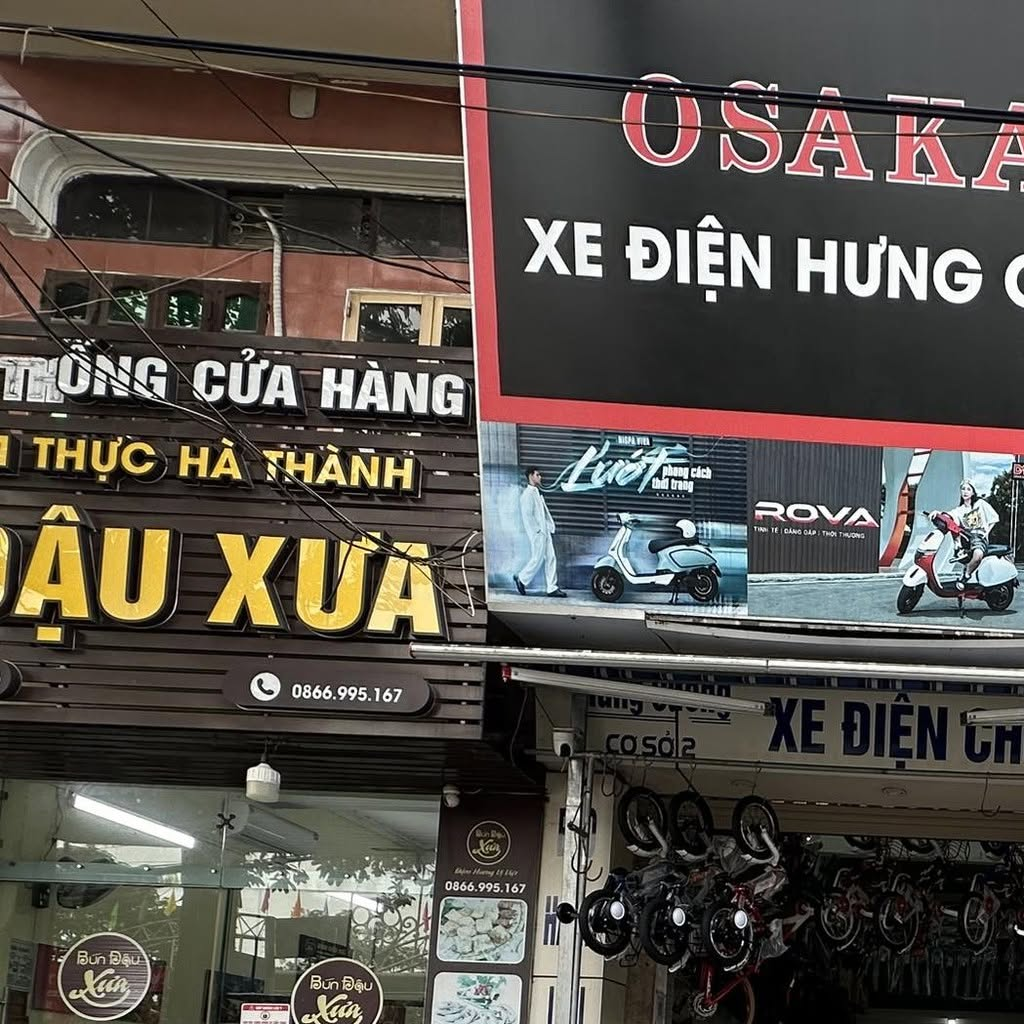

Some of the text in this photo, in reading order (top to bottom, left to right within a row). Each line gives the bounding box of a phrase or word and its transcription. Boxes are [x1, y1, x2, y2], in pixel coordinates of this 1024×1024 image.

[523, 217, 603, 278] XE
[625, 213, 772, 303] ĐIỆN
[797, 234, 983, 305] HƯNG
[192, 348, 299, 407] CỬA
[320, 360, 465, 416] HÀNG
[32, 436, 157, 482] THỰC
[178, 437, 243, 480] HÀ
[262, 443, 414, 490] THÀNH
[662, 464, 712, 480] phong cách
[670, 478, 694, 493] trang
[753, 500, 880, 528] ROVA
[204, 530, 441, 634] XƯA
[291, 683, 403, 703] 0866.995.167
[767, 696, 827, 754] XE
[841, 692, 949, 769] ĐIỆN
[680, 736, 697, 760] 2
[445, 881, 526, 894] 0866.995.167
[77, 950, 140, 968] Bún Đậu
[68, 968, 131, 1007] Xưa
[310, 975, 373, 994] Bún Đậu
